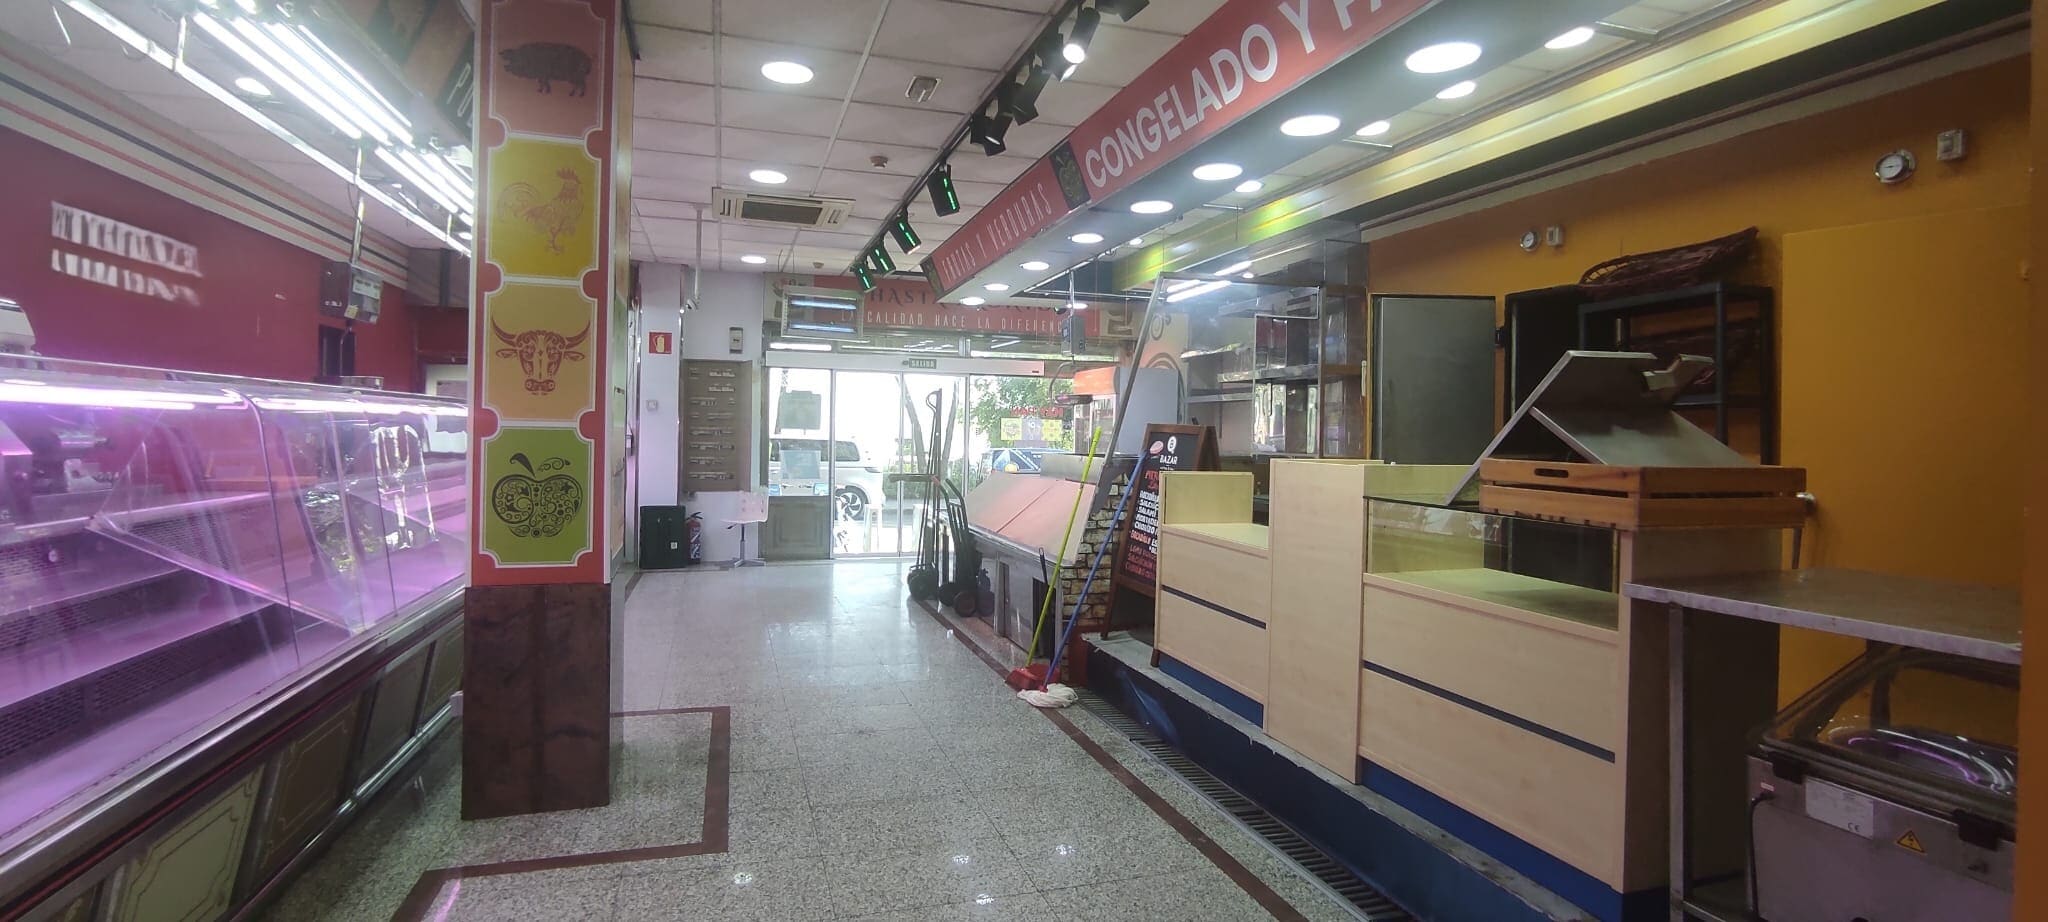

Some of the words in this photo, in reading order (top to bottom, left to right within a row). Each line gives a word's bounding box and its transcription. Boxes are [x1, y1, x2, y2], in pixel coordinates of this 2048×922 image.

[1085, 23, 1279, 188] CONGELADO
[1277, 0, 1316, 54] Y
[942, 241, 977, 283] FRUTAS
[985, 182, 1053, 252] VERDURAS
[866, 311, 924, 326] CALIDAD
[935, 313, 967, 329] HACE
[977, 318, 991, 330] LA
[1001, 317, 1064, 333] DIFERENC
[1159, 454, 1178, 465] BAZAR
